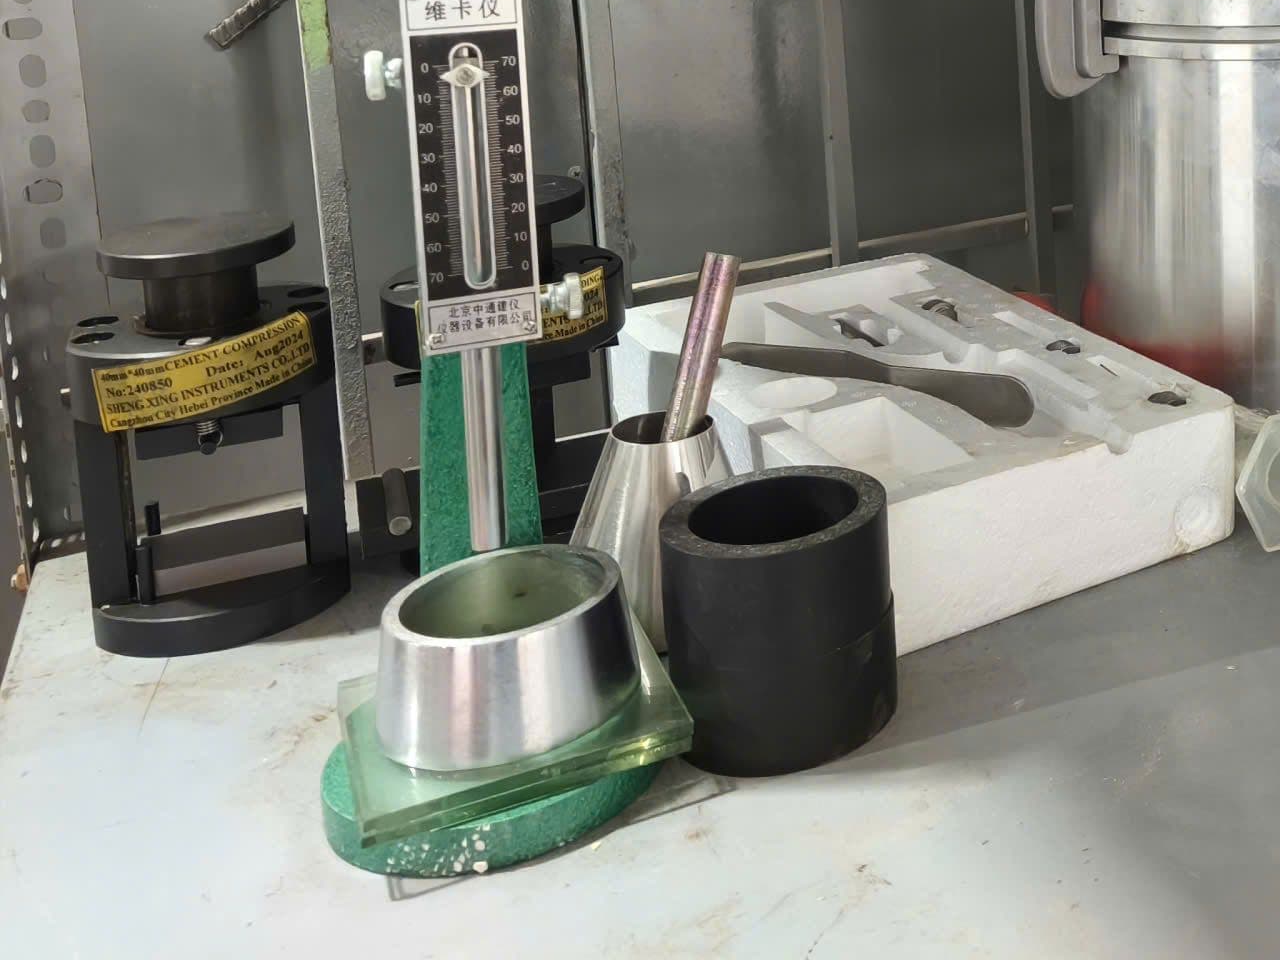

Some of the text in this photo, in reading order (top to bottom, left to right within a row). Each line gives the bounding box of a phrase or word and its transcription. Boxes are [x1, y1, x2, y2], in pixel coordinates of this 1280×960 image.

[502, 55, 516, 66] 70
[420, 63, 429, 73] 0
[503, 86, 518, 96] 60
[417, 93, 431, 104] 10
[505, 115, 520, 125] 50
[418, 123, 433, 134] 20
[507, 144, 523, 154] 40
[420, 152, 436, 163] 30
[509, 172, 524, 183] 30
[422, 182, 437, 193] 40
[511, 202, 526, 213] 20
[424, 212, 440, 223] 50
[514, 231, 528, 241] 10
[426, 242, 442, 253] 60
[521, 260, 529, 270] 0
[429, 272, 444, 283] 70
[222, 315, 301, 356] COMPRESSION
[205, 360, 244, 378] Date:
[254, 329, 304, 361] Aug2024
[106, 399, 145, 414] SHENG
[181, 362, 270, 401] INSTRUMENTS
